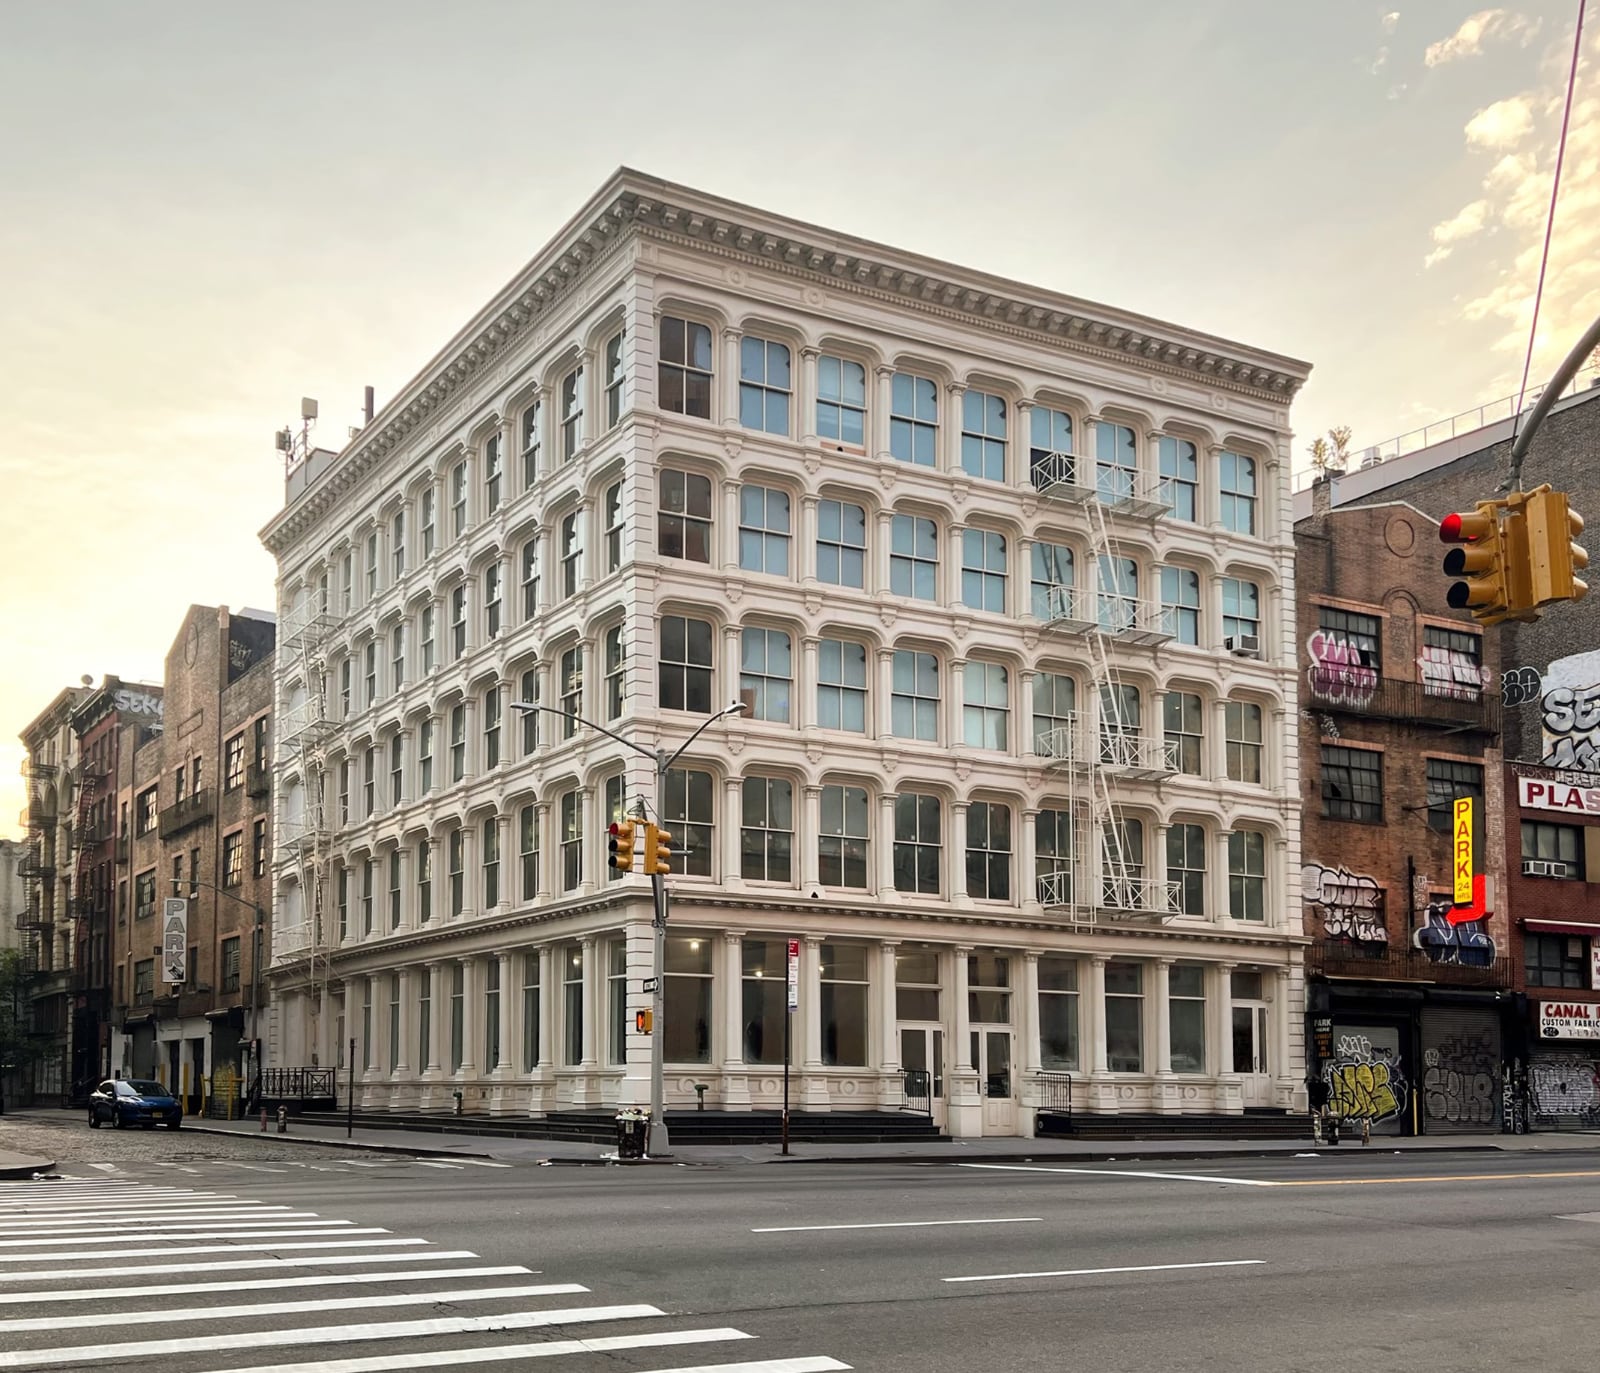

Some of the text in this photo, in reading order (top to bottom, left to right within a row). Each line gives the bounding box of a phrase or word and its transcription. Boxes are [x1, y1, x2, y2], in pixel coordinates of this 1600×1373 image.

[1527, 782, 1600, 811] PLAS
[1456, 801, 1470, 879] PARK
[1457, 882, 1470, 891] 24
[165, 900, 185, 967] PARK
[1545, 1003, 1590, 1019] CANAL
[1541, 1018, 1600, 1028] CUSTOM FABRIC
